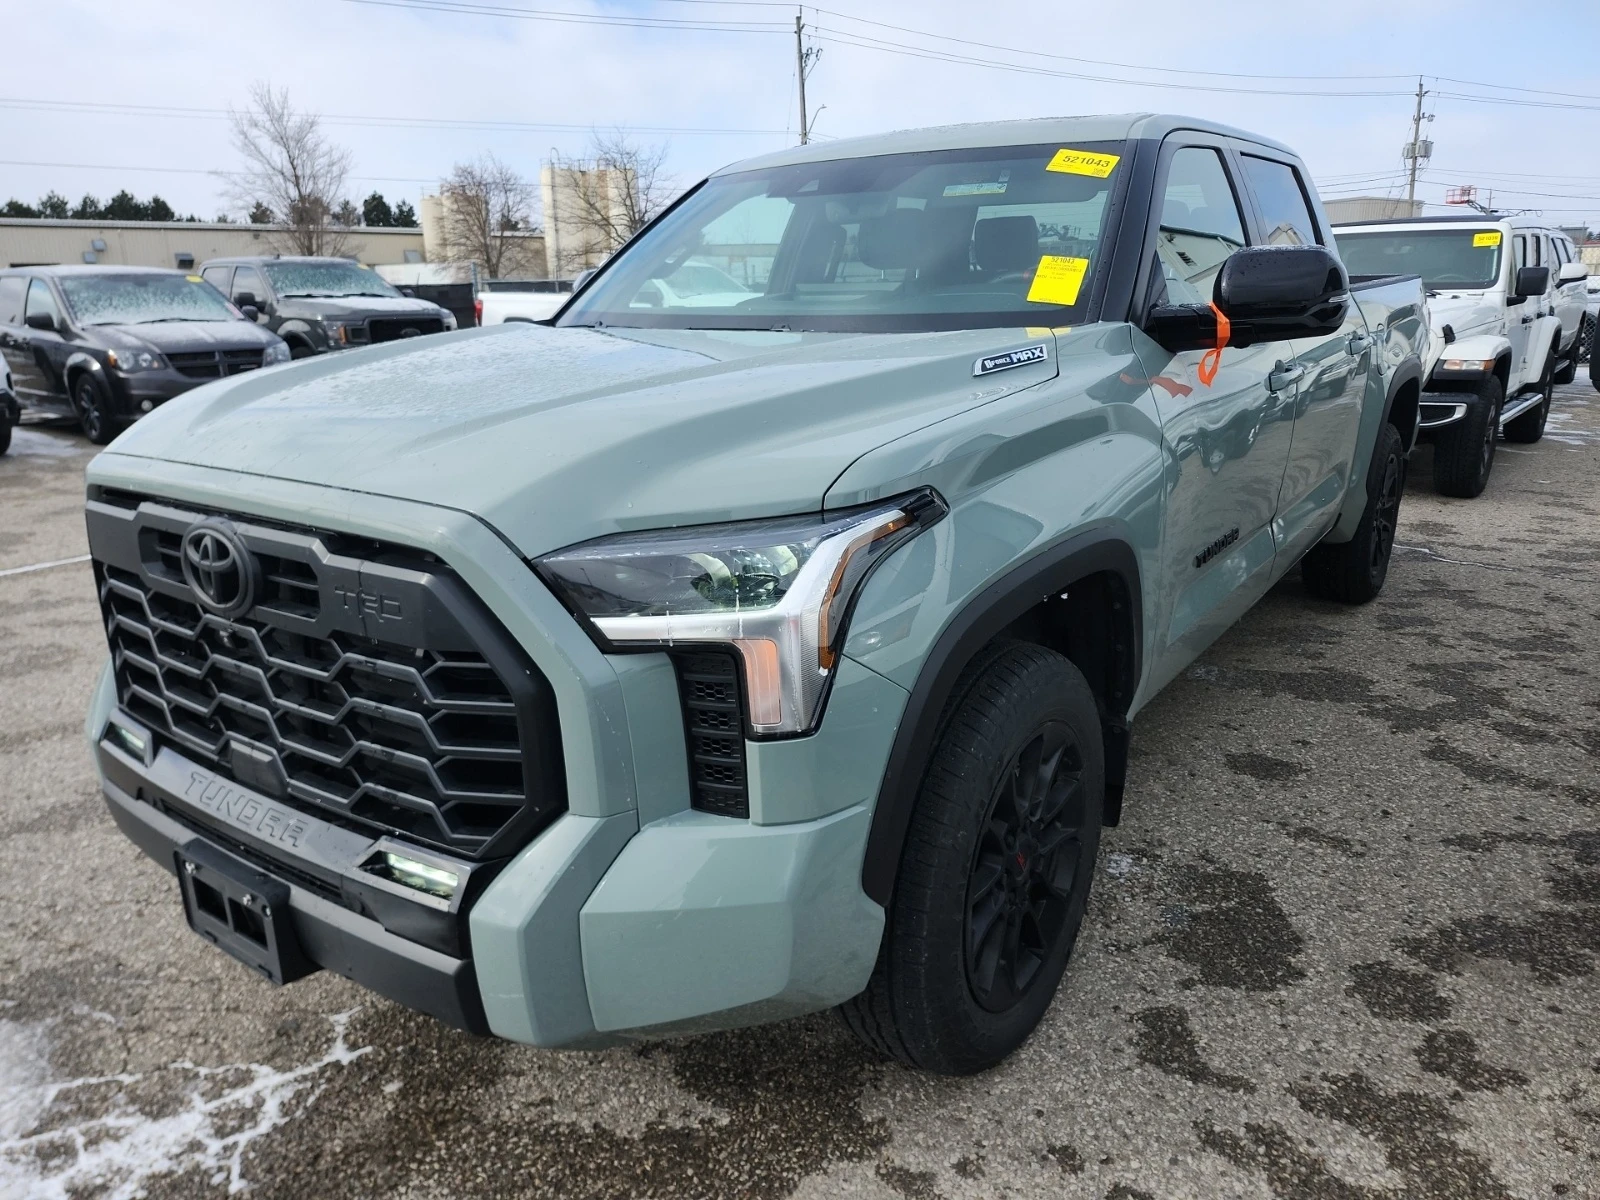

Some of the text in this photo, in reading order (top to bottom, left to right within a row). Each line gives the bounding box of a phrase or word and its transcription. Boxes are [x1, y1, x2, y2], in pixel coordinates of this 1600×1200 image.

[1062, 155, 1111, 168] 521043
[1010, 347, 1044, 363] MAX
[1195, 527, 1240, 569] TUNDRA
[334, 586, 403, 623] TRD
[184, 771, 309, 848] TUNDRA
